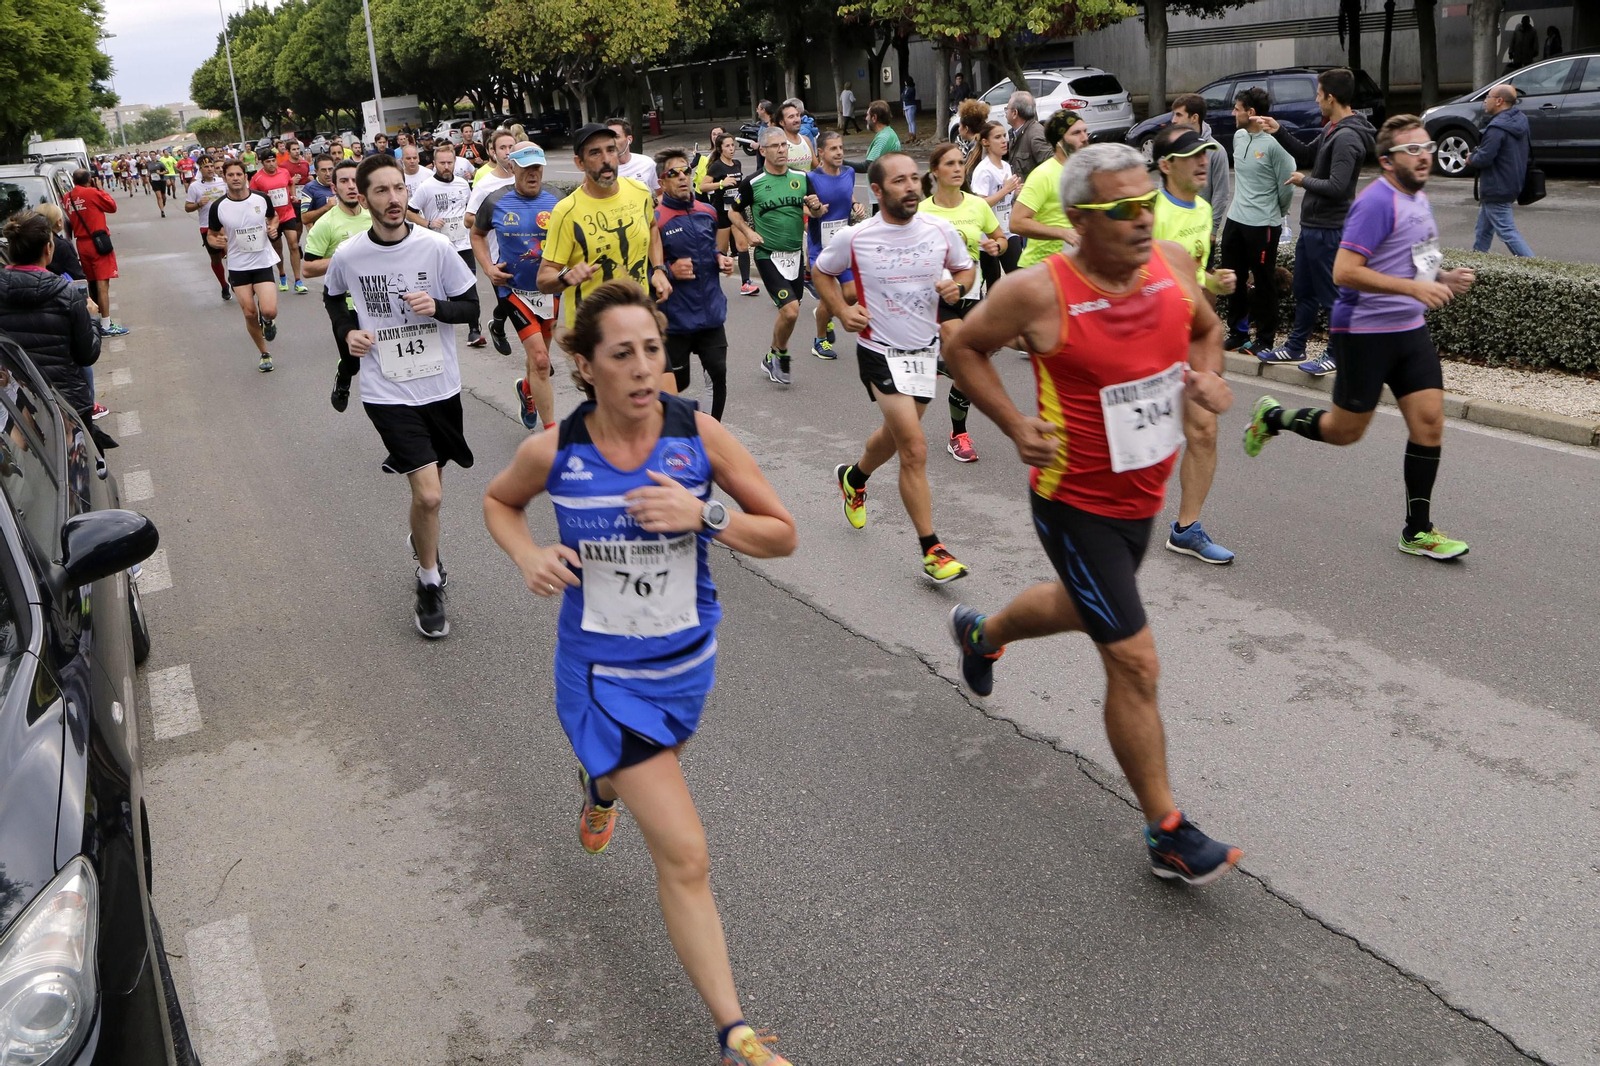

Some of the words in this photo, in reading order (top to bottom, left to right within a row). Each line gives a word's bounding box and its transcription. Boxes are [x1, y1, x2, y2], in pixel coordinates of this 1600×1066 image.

[778, 194, 804, 206] VERD
[450, 223, 459, 231] 57
[583, 210, 609, 236] 30
[246, 234, 257, 242] 33
[665, 227, 684, 237] KELME
[780, 259, 796, 269] 728
[358, 275, 389, 292] XXXIX
[363, 291, 390, 303] CARRERA
[366, 302, 392, 314] POPULAR
[377, 327, 401, 342] XXXIX
[400, 324, 419, 333] CARRERA
[419, 322, 438, 330] POPULAR
[395, 339, 425, 358] 143
[903, 360, 925, 375] 211
[1134, 398, 1173, 431] 204
[566, 514, 610, 529] Club
[584, 542, 627, 565] XXXIX
[631, 544, 665, 555] CARRERA
[615, 569, 669, 598] 767
